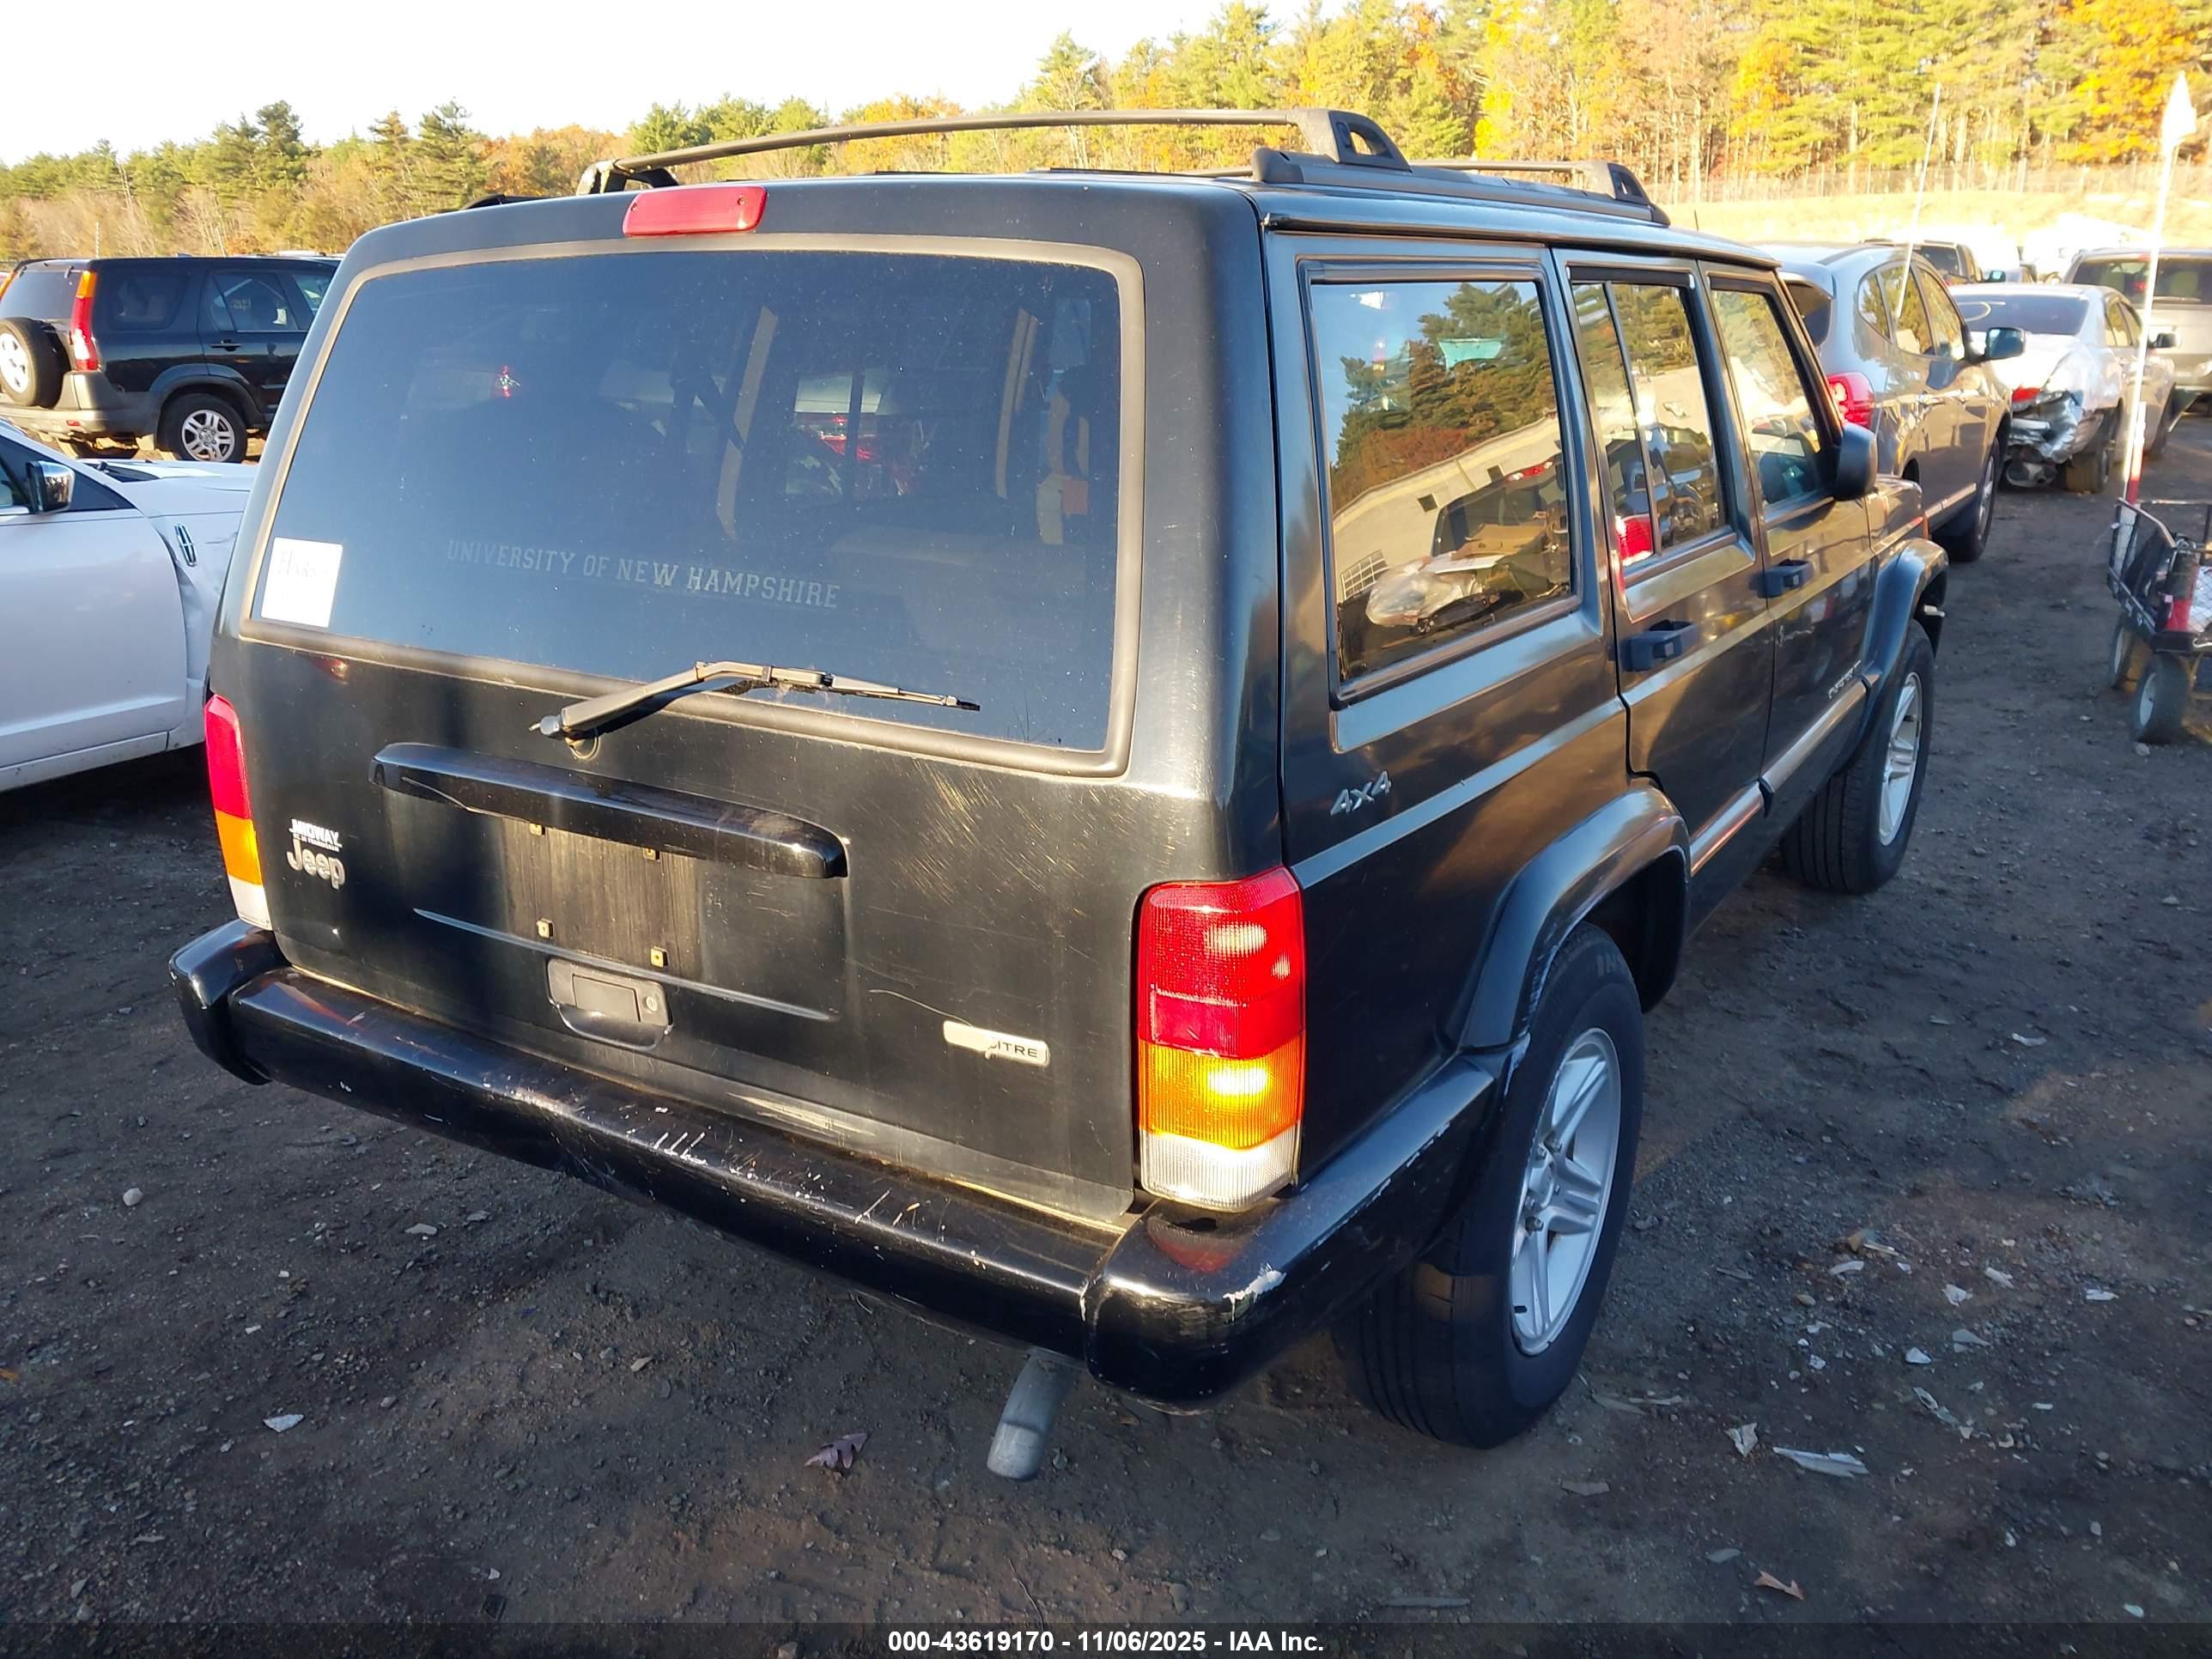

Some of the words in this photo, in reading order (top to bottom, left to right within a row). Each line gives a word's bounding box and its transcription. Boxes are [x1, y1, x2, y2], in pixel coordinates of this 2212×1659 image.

[447, 539, 576, 574] UNIVERSITY
[583, 554, 611, 578] OF
[615, 558, 680, 587] NEW
[687, 567, 841, 608] HAMPSHIRE
[286, 837, 346, 890] Jeep
[988, 1040, 1038, 1059] ITRE
